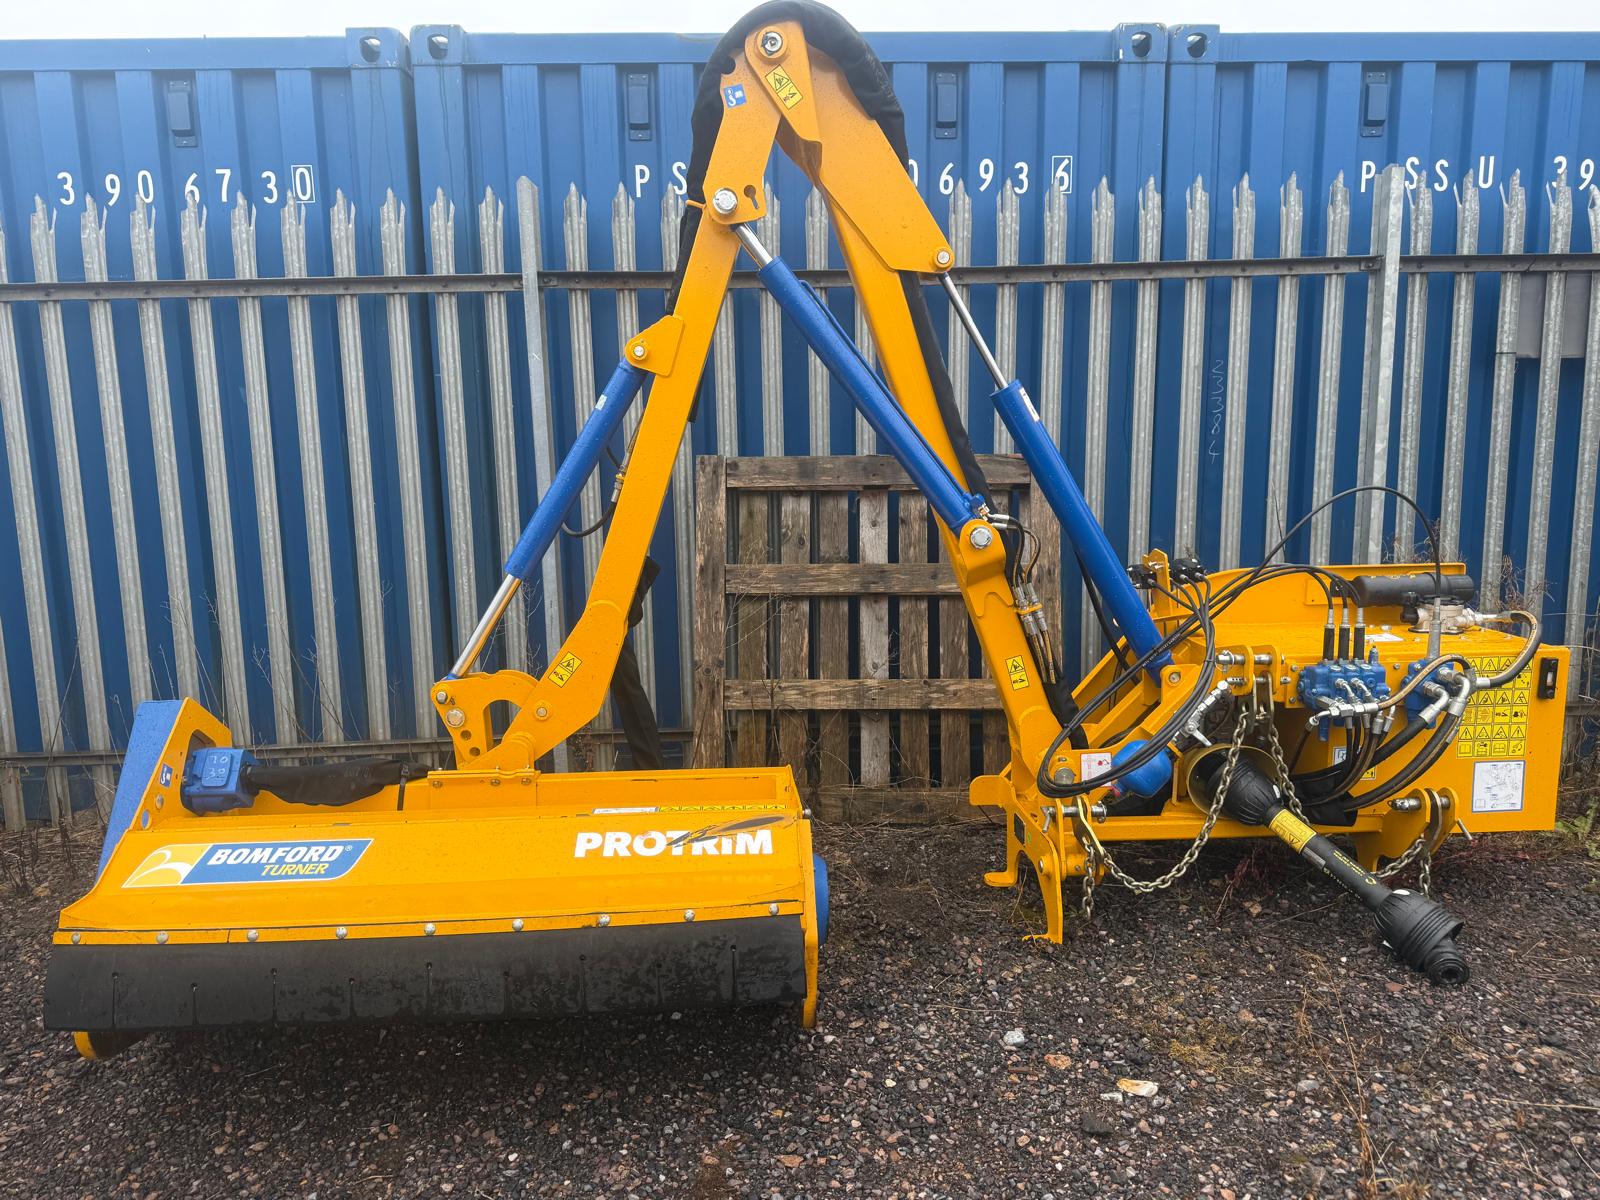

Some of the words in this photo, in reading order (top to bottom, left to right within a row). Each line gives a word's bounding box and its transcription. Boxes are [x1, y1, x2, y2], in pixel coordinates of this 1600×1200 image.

[574, 829, 773, 858] PROTRIM
[206, 845, 345, 866] BOMFORD
[260, 863, 330, 877] TURNER
